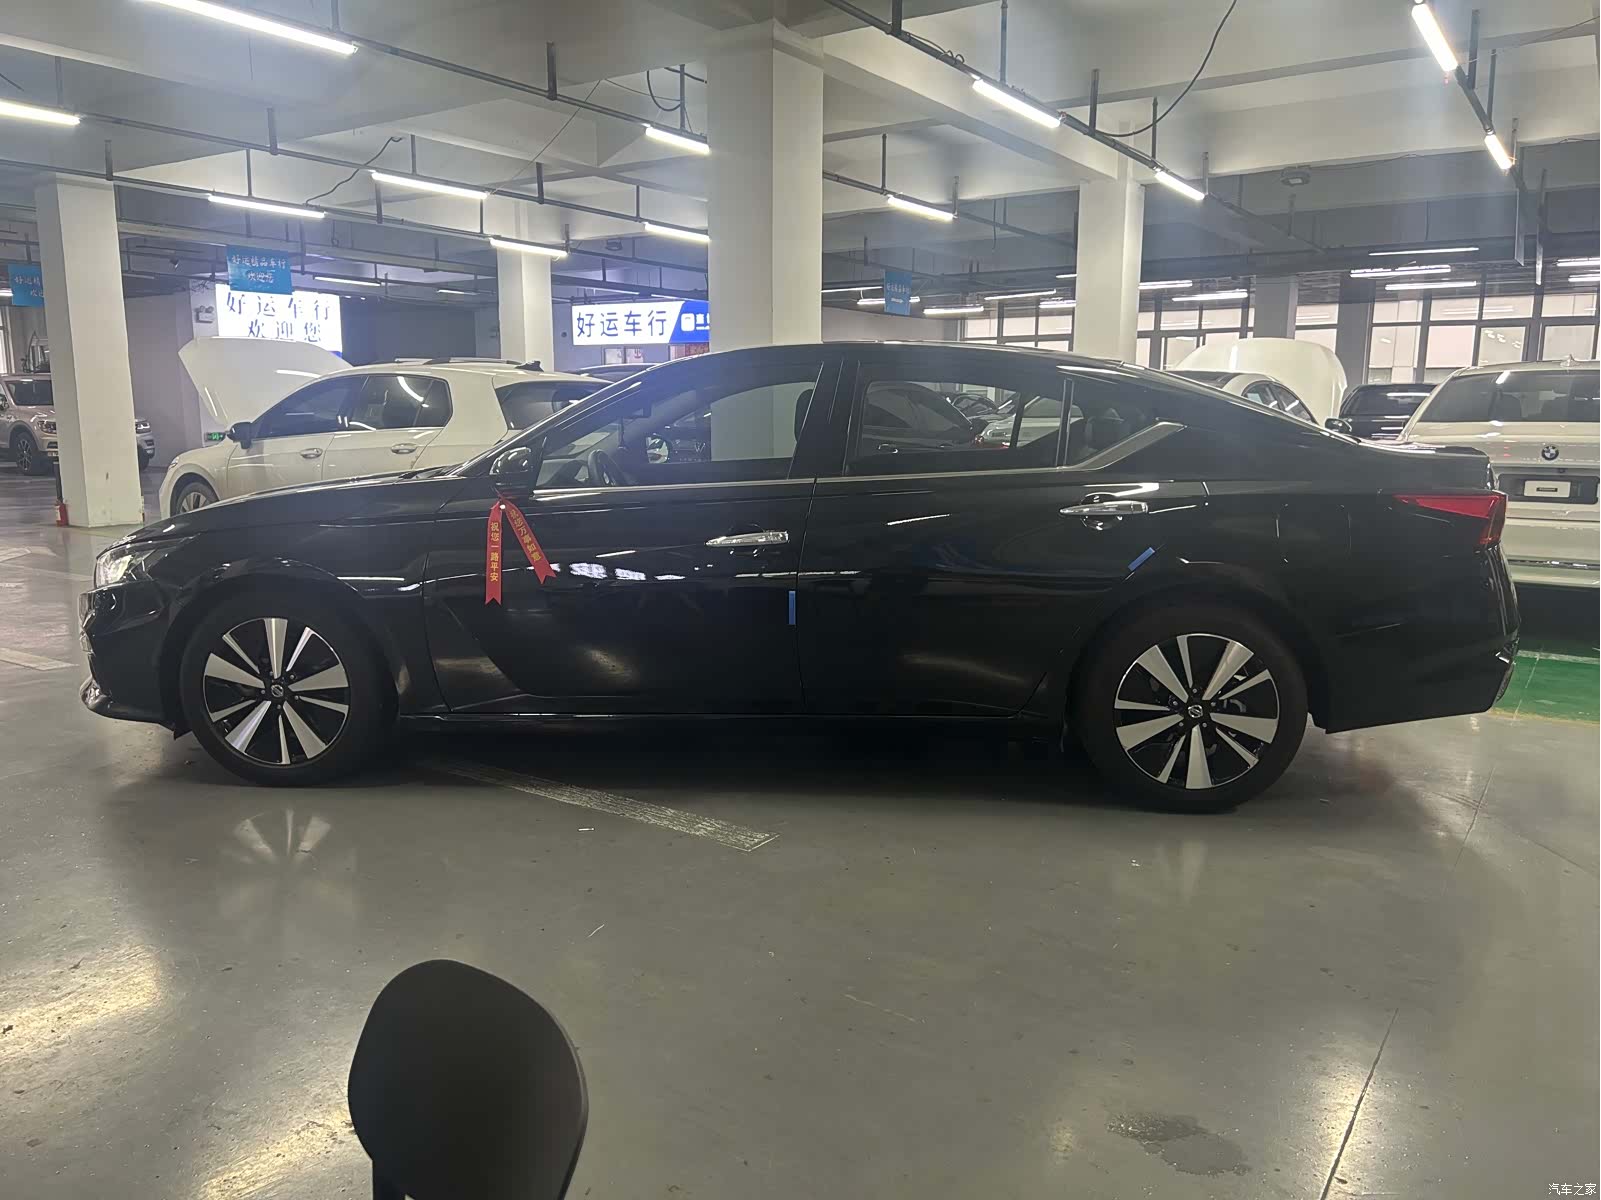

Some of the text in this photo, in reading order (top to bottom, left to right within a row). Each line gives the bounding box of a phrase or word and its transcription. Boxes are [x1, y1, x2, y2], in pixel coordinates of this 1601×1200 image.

[247, 319, 322, 343] 欢迎您
[576, 310, 667, 338] 好运车行
[490, 522, 500, 581] 祝您一路平安
